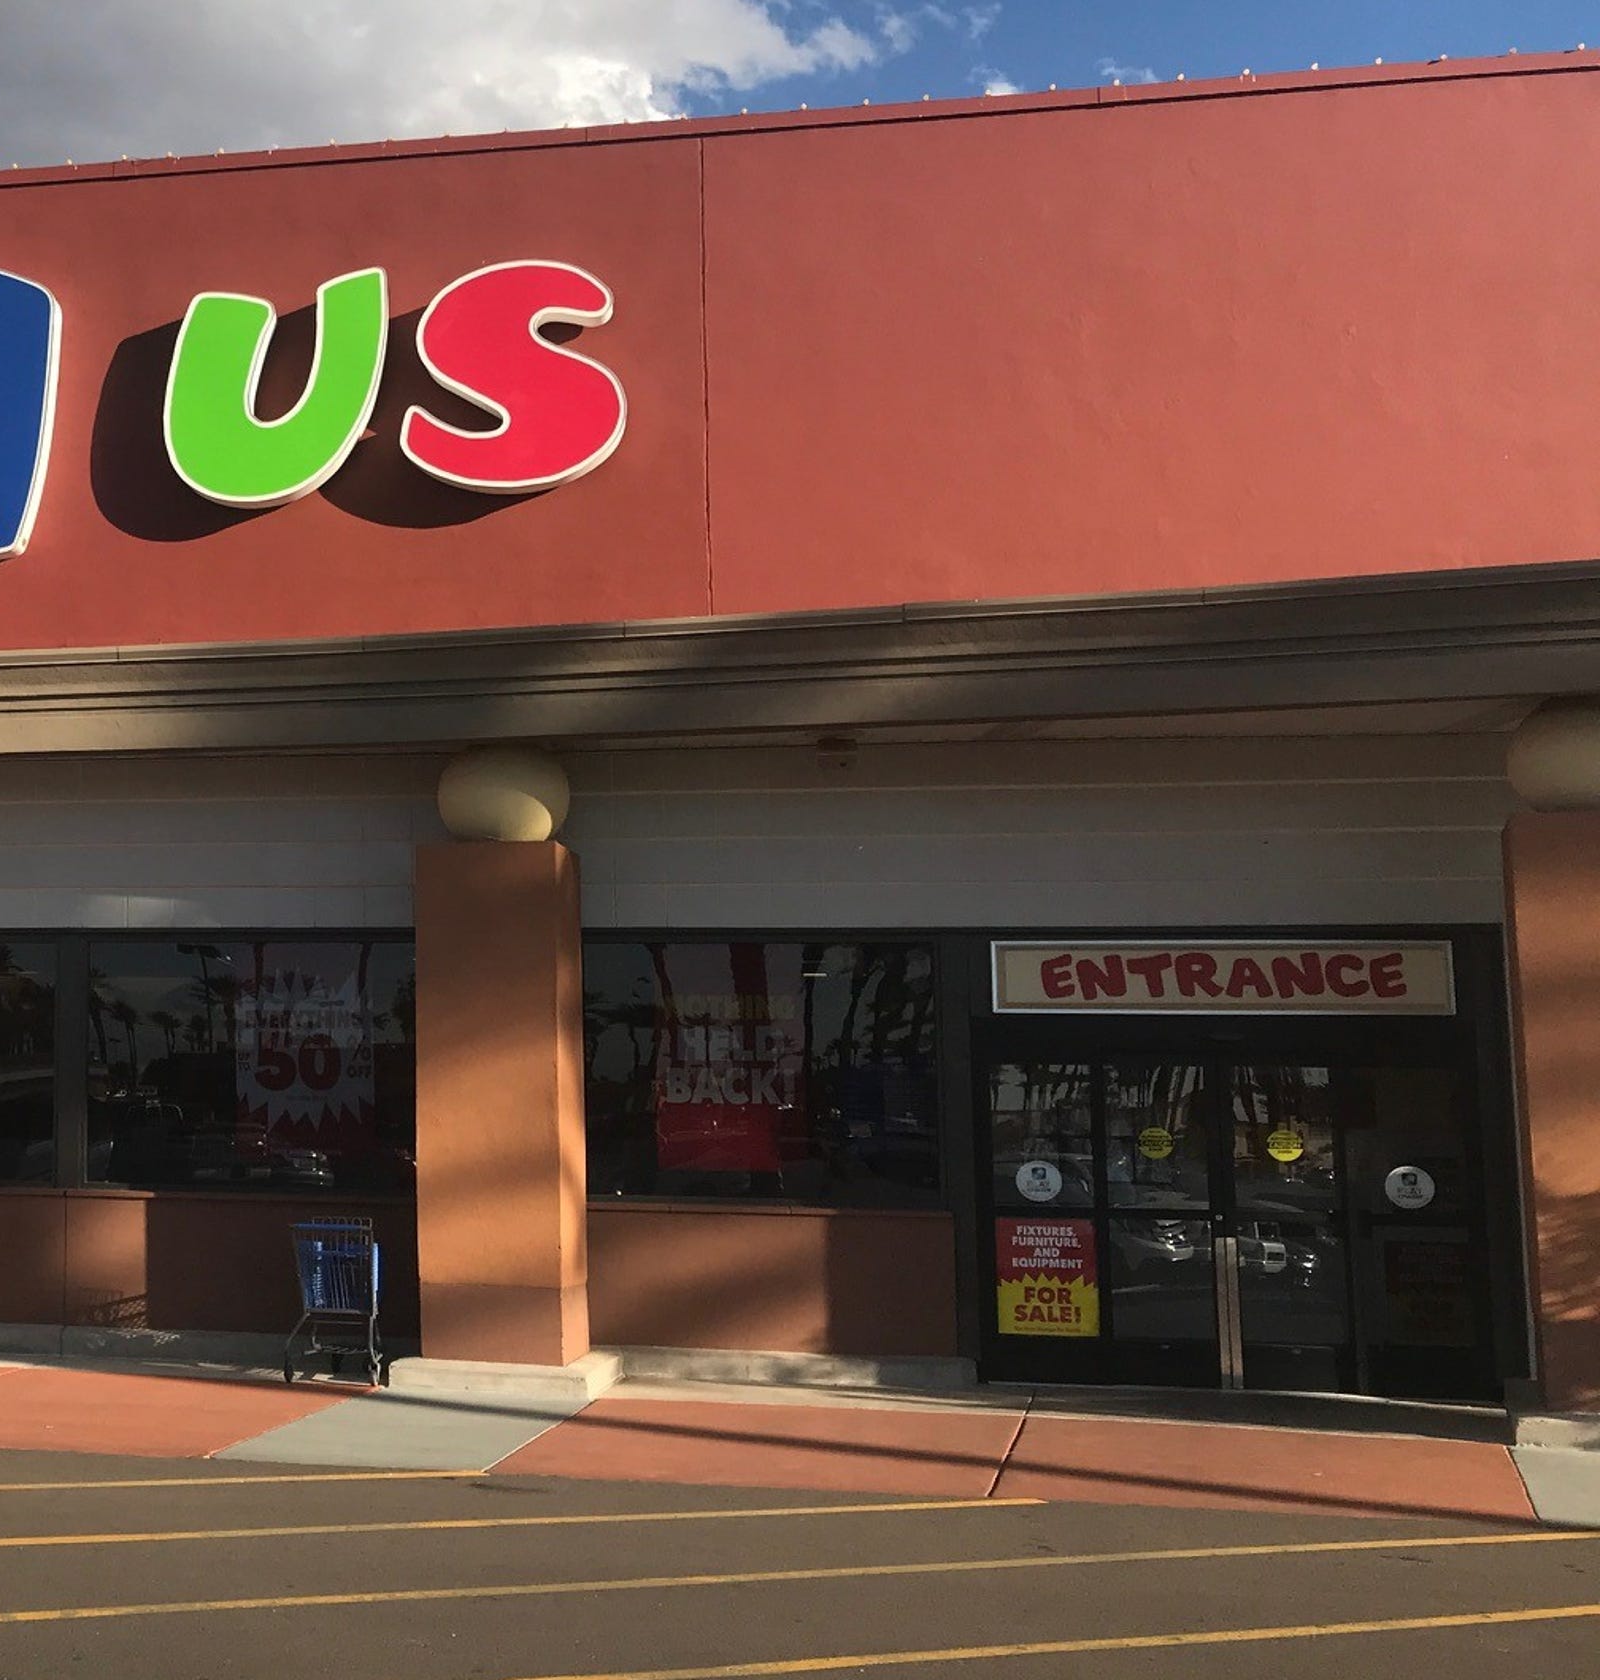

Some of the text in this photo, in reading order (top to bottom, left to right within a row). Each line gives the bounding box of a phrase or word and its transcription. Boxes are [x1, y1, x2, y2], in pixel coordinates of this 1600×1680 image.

[163, 259, 627, 508] US
[1041, 952, 1408, 1000] ENTRANCE
[677, 1025, 785, 1062] HELD
[665, 1067, 796, 1104] BACK!
[1012, 1236, 1082, 1249] FURNITURE,
[1033, 1247, 1060, 1258] AND
[1012, 1257, 1083, 1269] EQUIPMENT
[1024, 1287, 1073, 1304] FOR
[1014, 1304, 1081, 1323] SALE!
